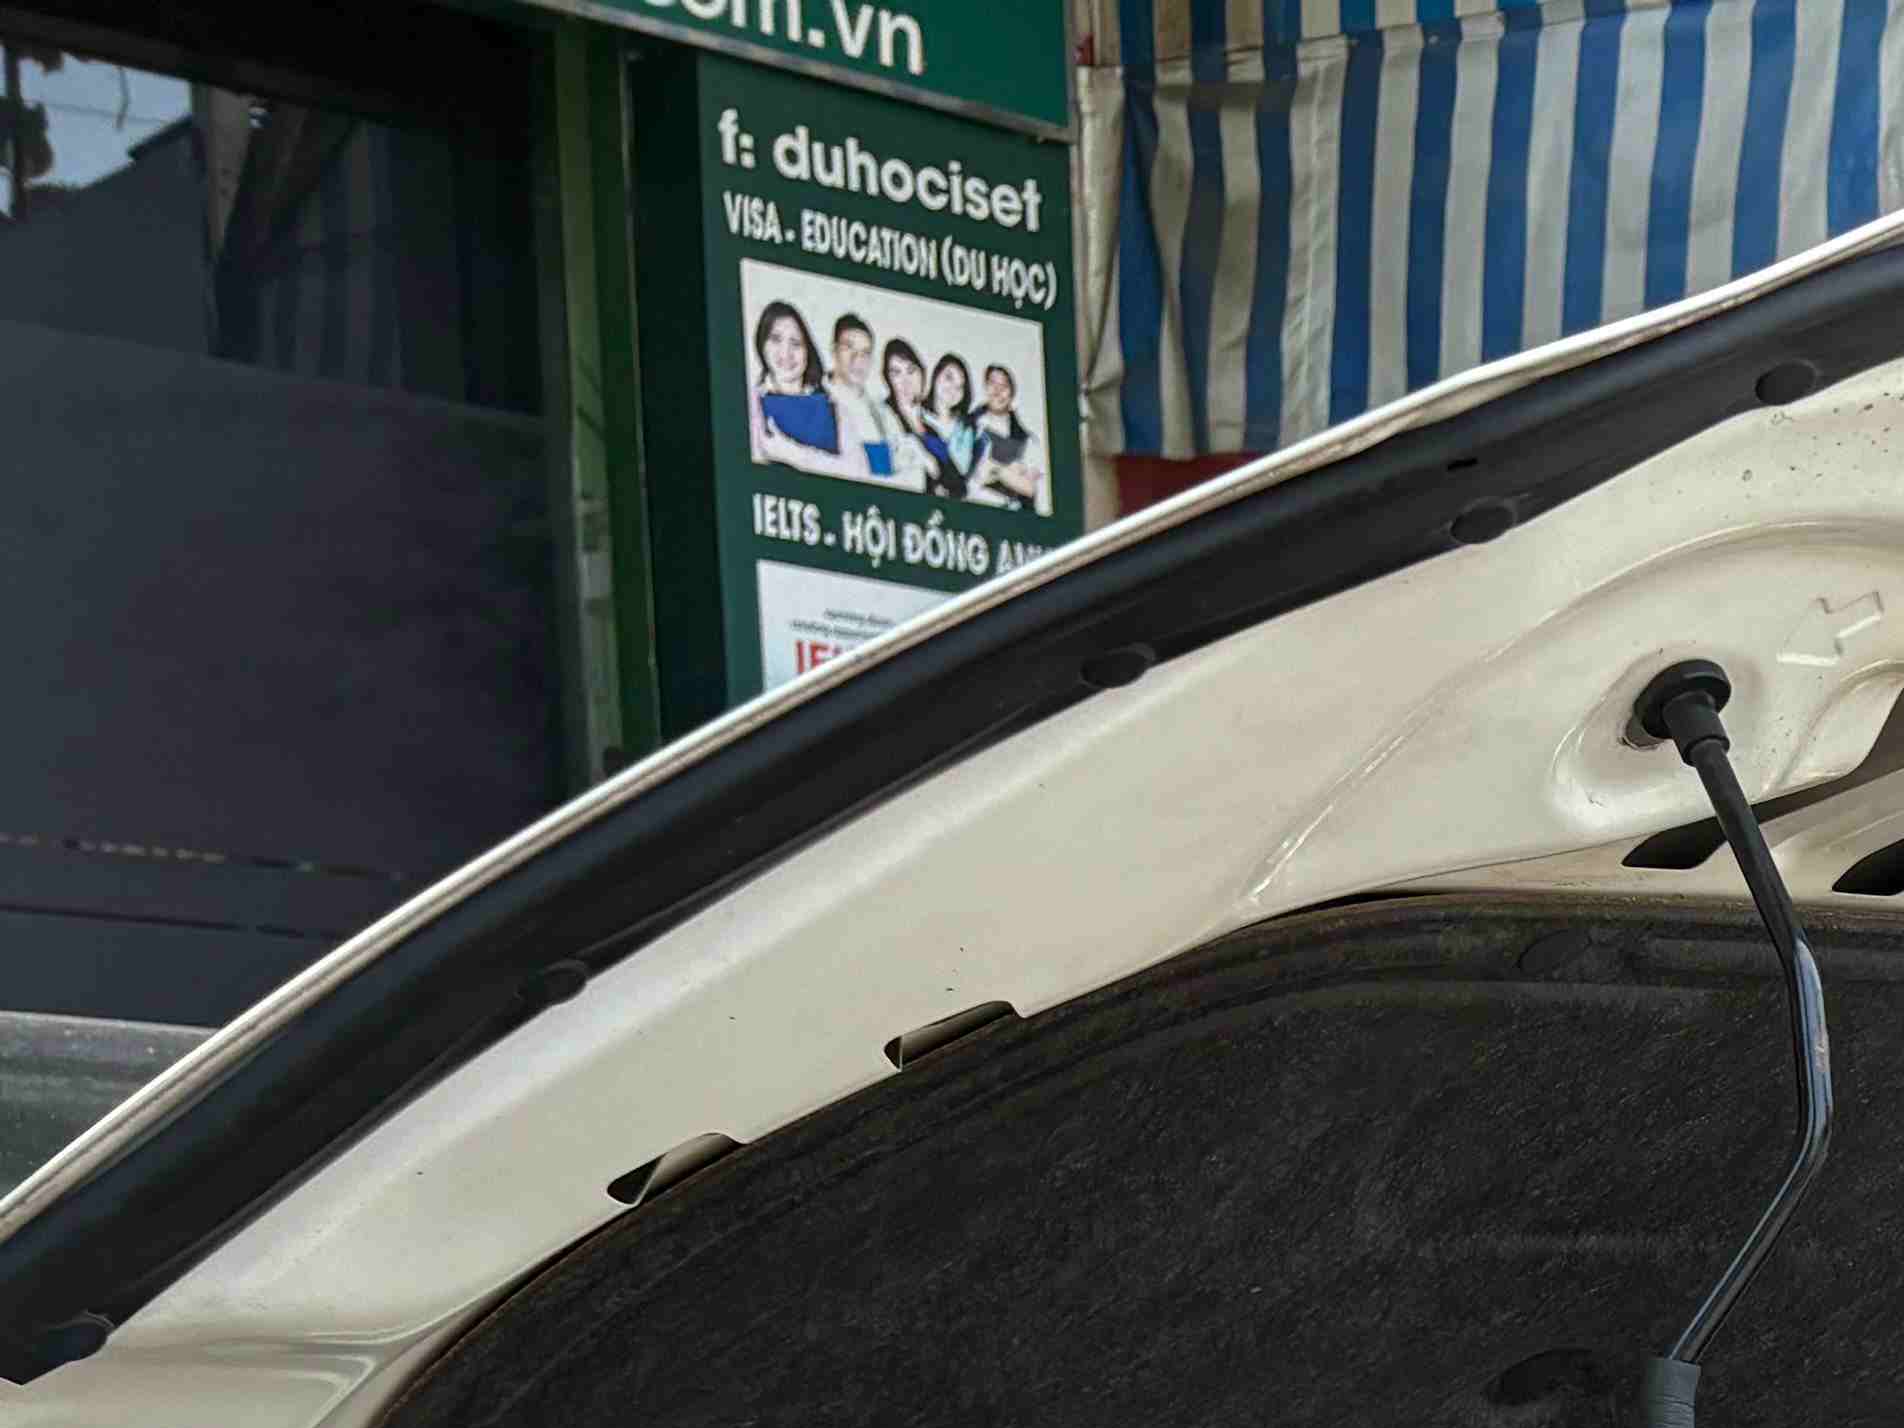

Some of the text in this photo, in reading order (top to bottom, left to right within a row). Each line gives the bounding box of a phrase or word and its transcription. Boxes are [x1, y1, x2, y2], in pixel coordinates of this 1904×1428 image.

[772, 124, 1042, 232] duhociset
[801, 208, 938, 280] EDUCATION
[842, 504, 897, 568] HỘI
[902, 508, 990, 576] ĐỒNG
